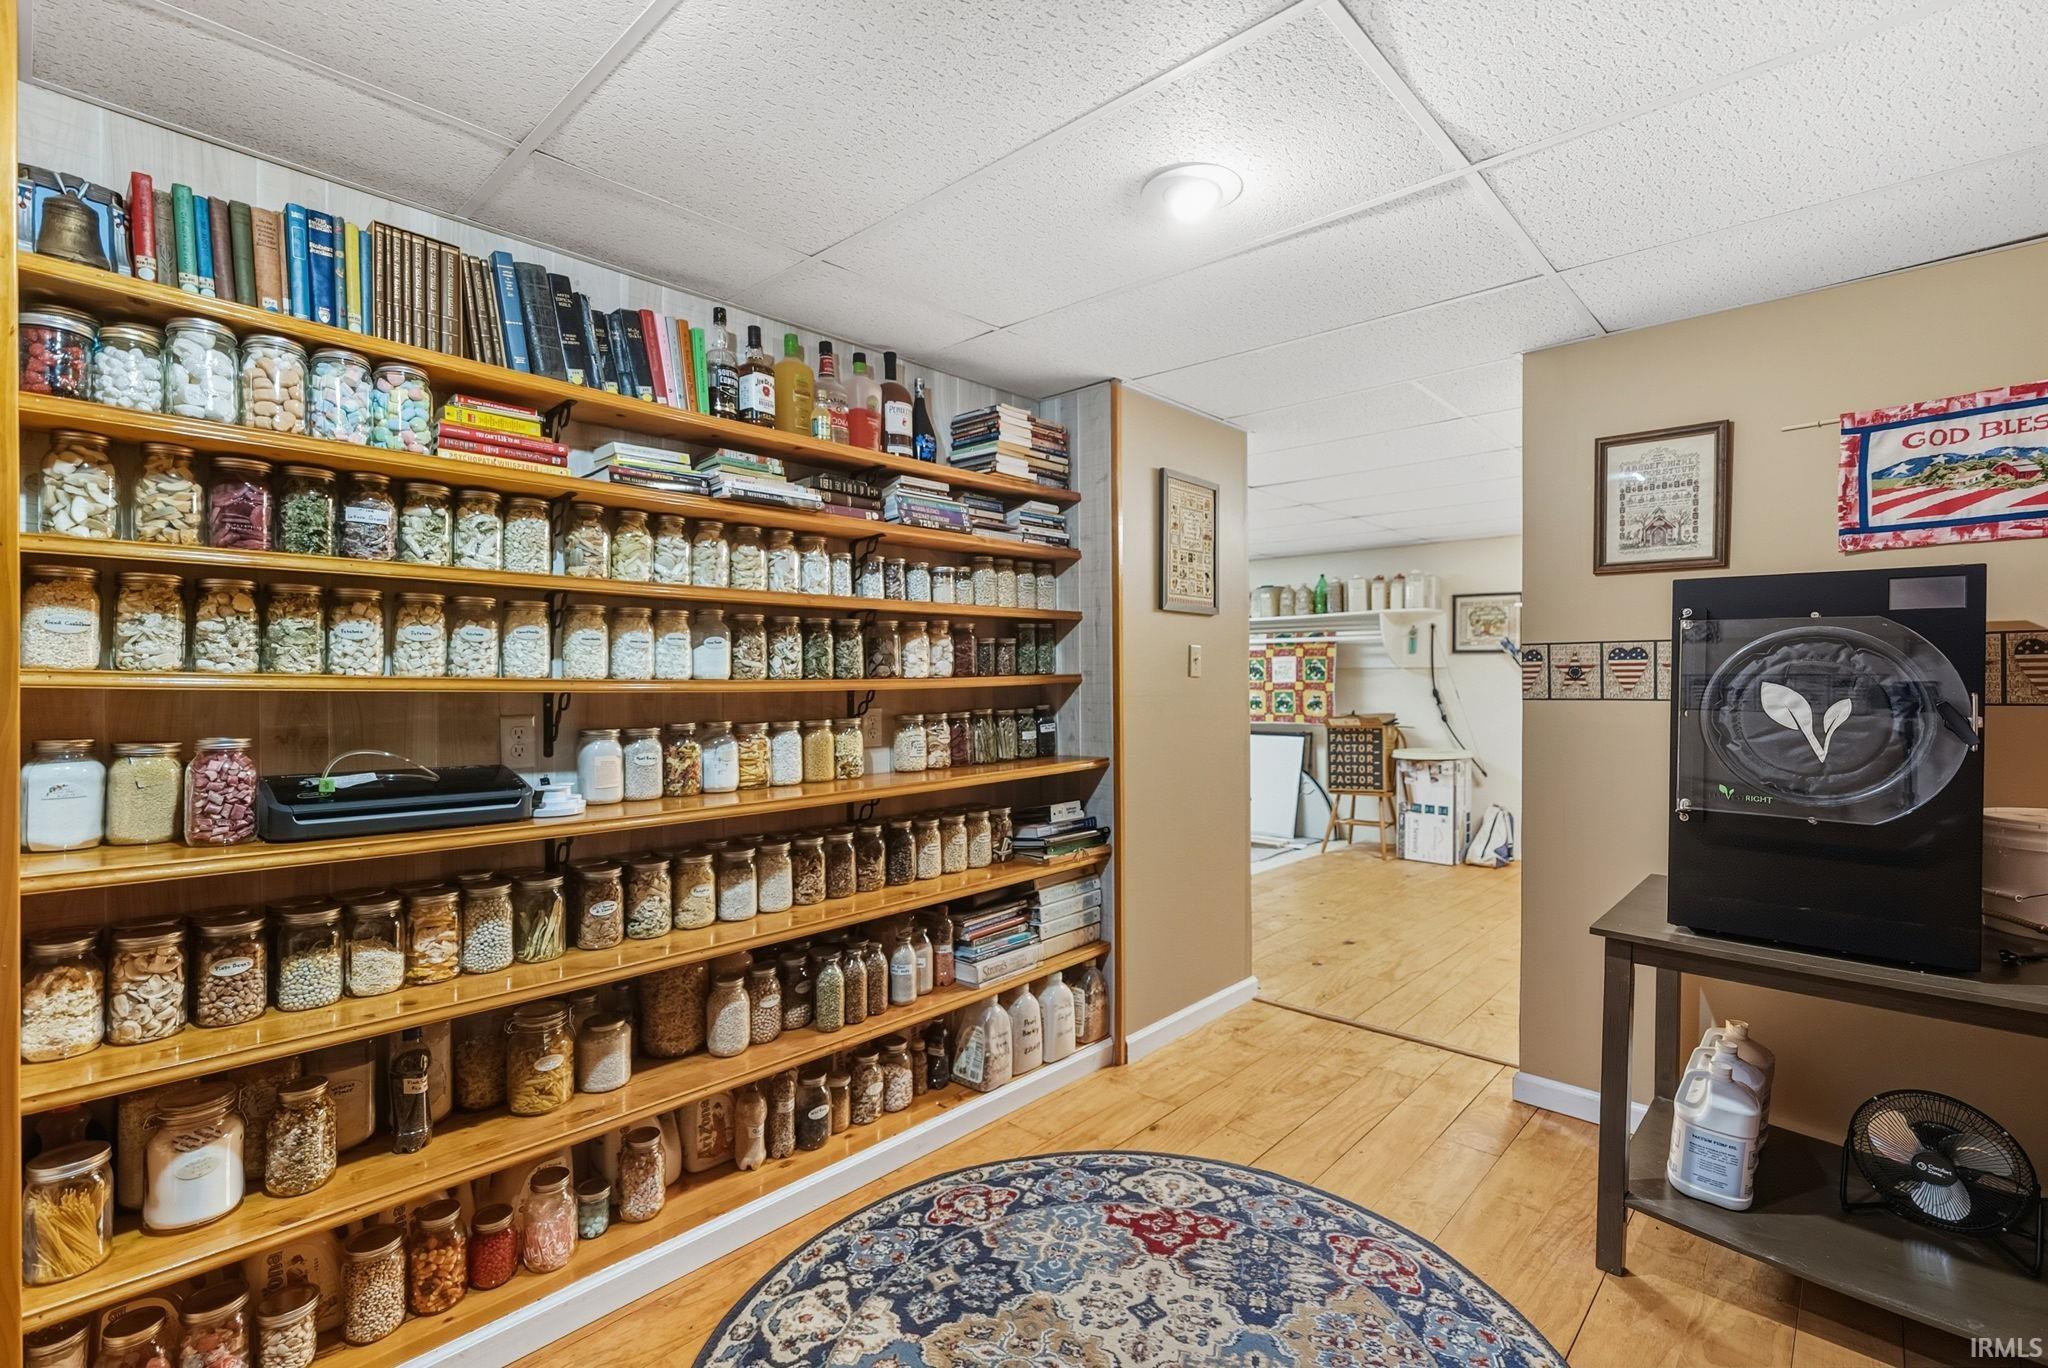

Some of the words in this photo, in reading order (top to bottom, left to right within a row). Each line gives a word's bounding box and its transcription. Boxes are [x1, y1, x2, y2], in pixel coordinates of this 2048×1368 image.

[1902, 428, 1970, 449] GOD
[1979, 413, 2048, 440] BLES
[1745, 795, 1773, 804] RIGHT
[1927, 1163, 1952, 1176] Comfort
[1927, 1169, 1943, 1178] Zone
